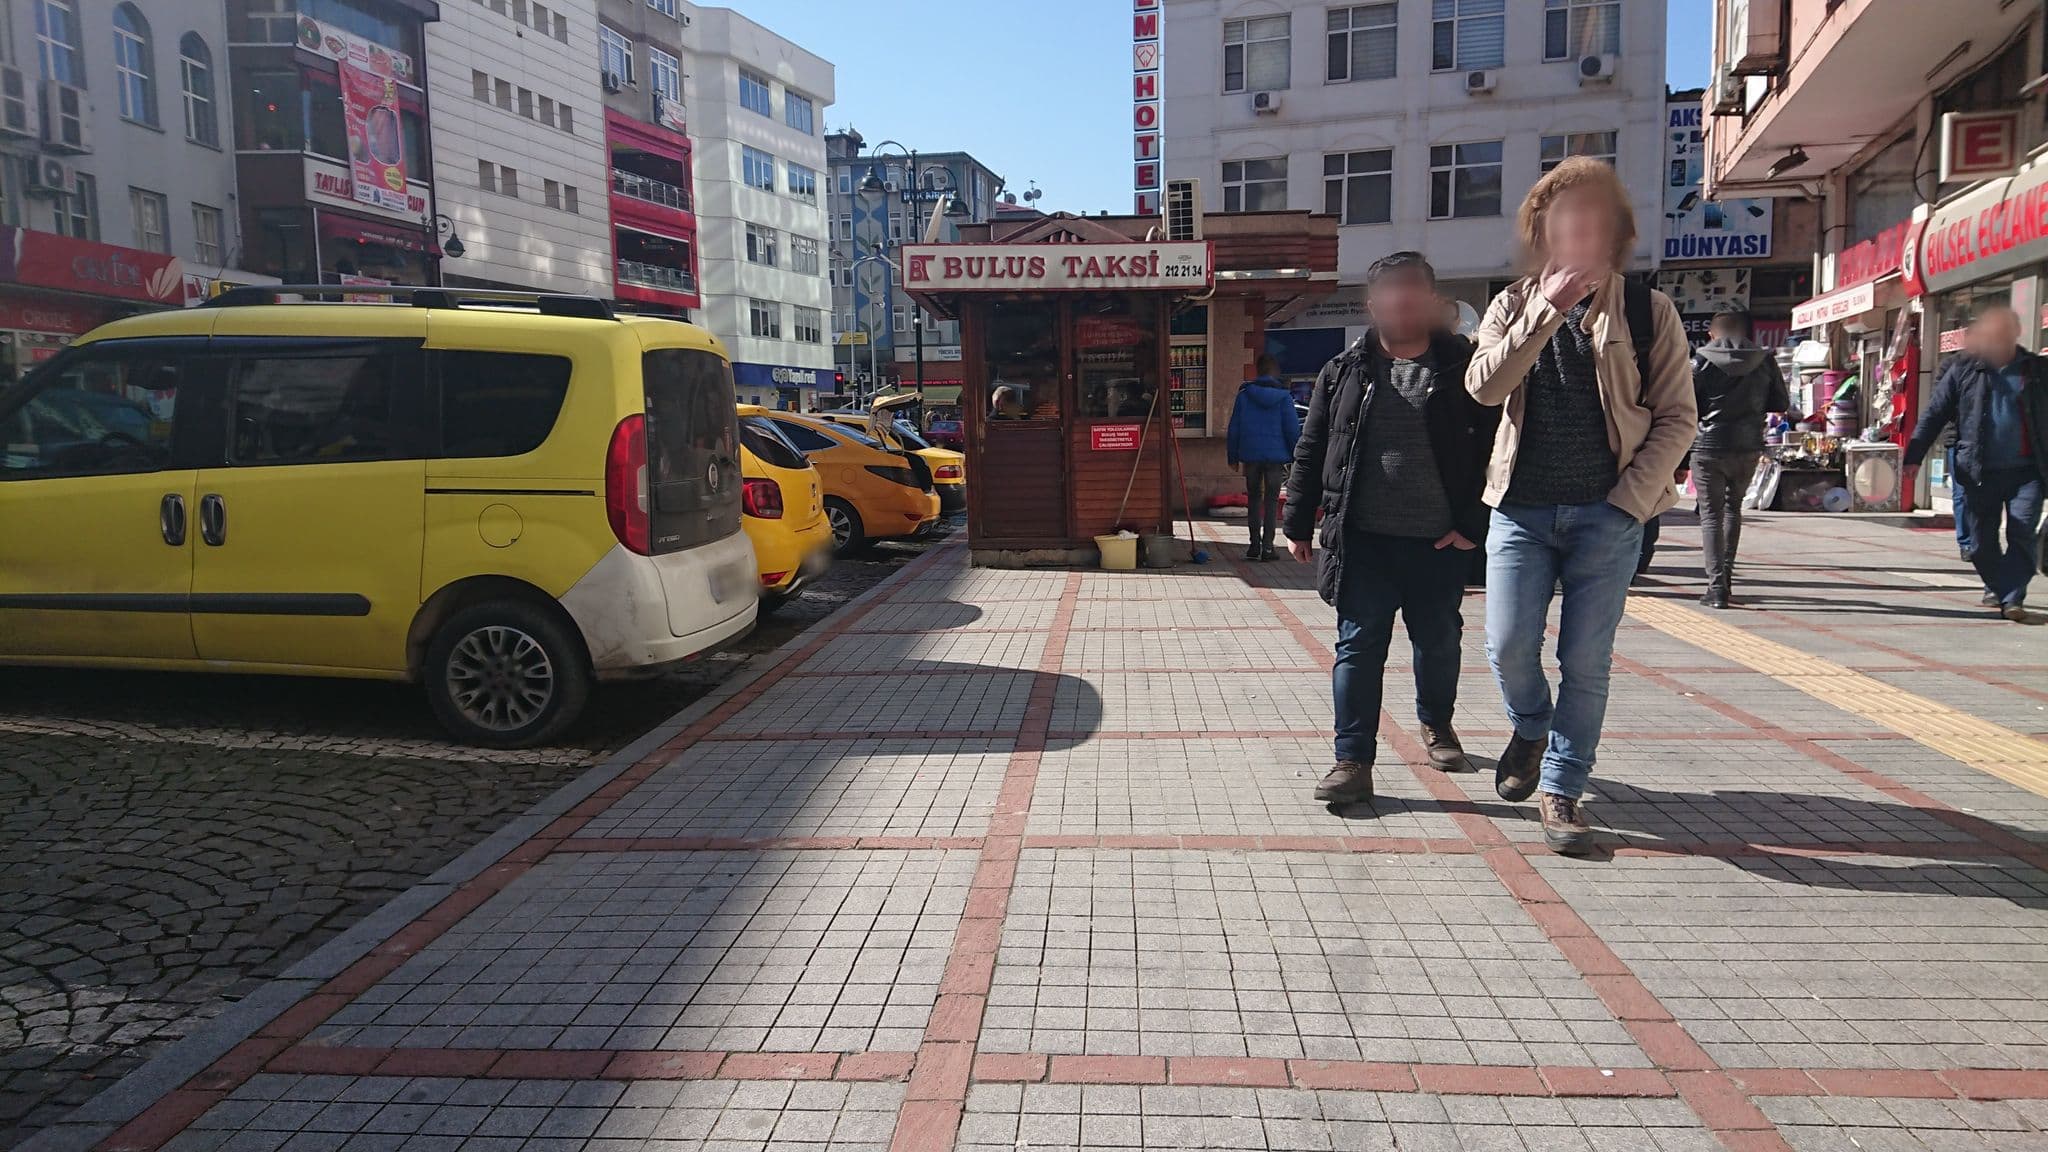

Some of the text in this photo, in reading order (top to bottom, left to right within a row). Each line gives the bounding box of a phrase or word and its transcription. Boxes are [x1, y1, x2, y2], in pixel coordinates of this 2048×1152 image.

[1136, 75, 1155, 215] HOTEL
[1964, 124, 2004, 166] E
[1665, 233, 1767, 258] DÜNYASI
[1062, 250, 1160, 279] TAKSİ
[1165, 264, 1202, 277] 212 21 34
